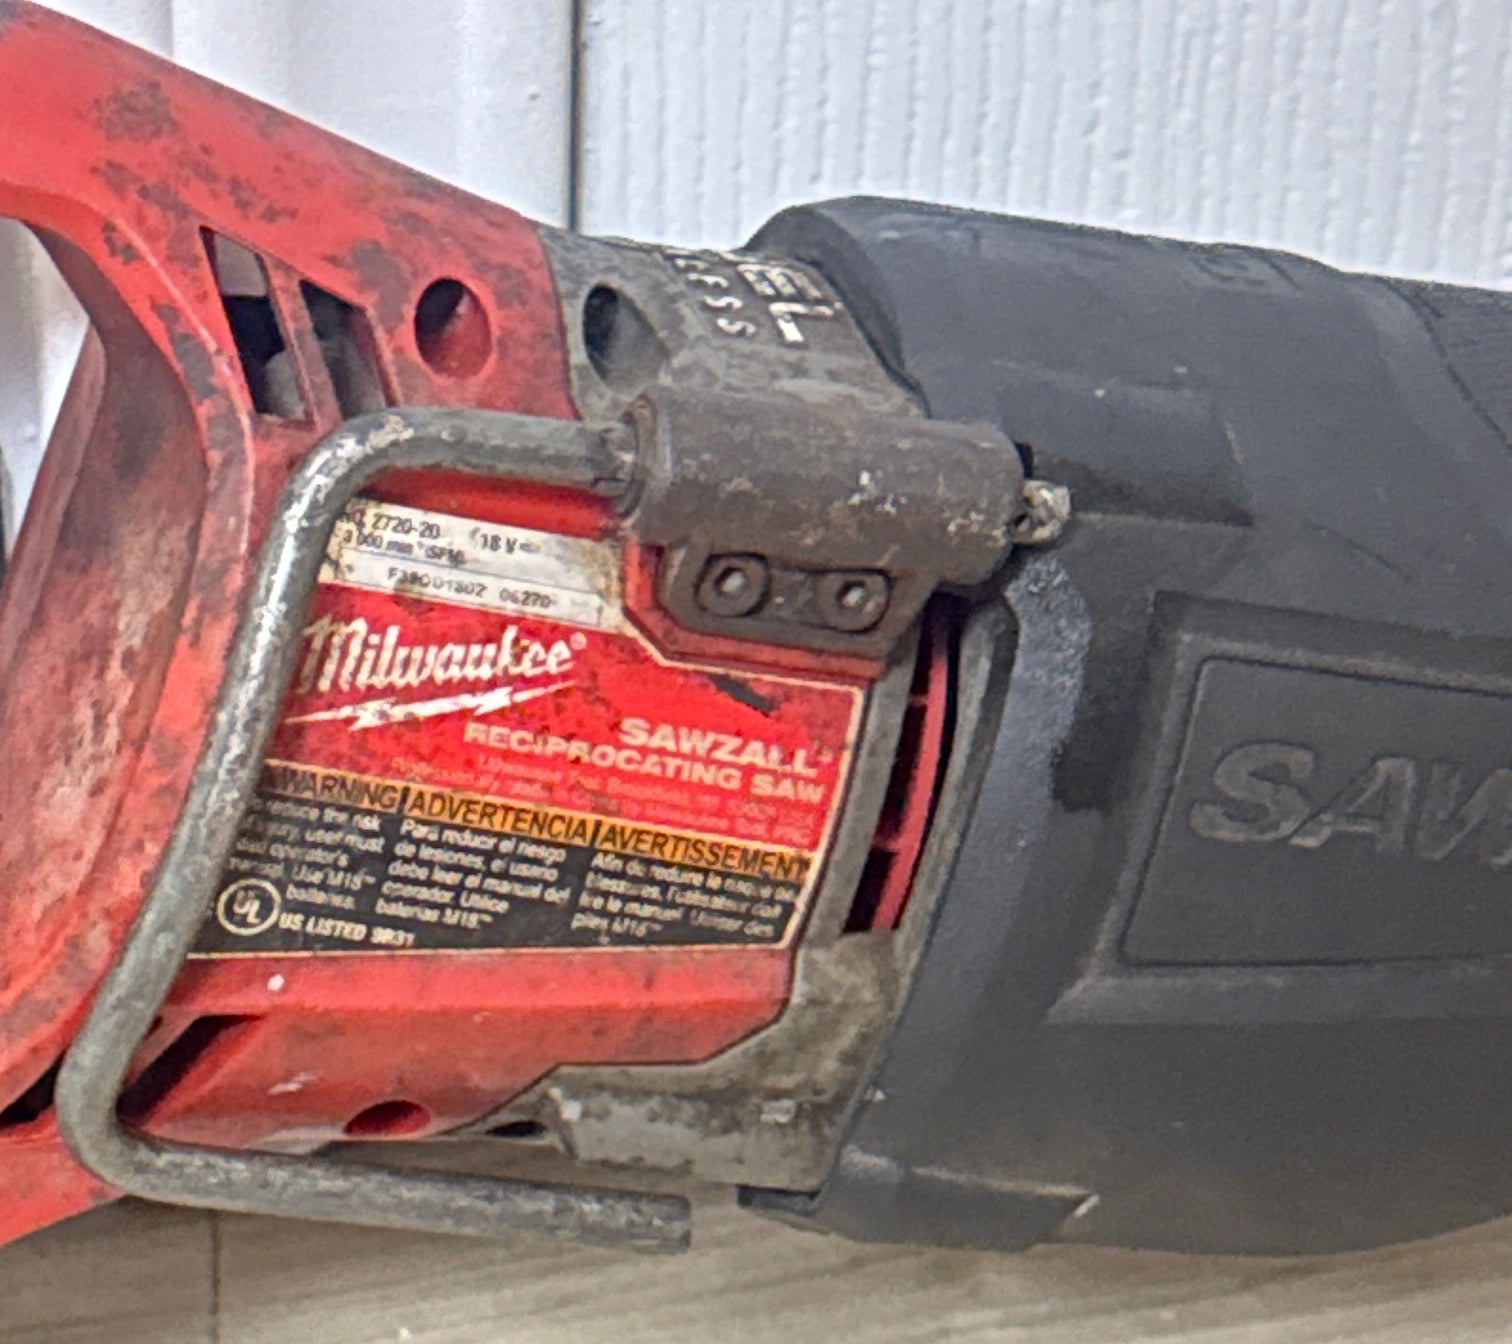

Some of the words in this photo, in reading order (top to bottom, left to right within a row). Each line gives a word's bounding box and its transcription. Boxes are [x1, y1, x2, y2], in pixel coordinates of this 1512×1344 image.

[371, 513, 440, 539] 2720-20
[479, 533, 501, 552] 18
[505, 536, 518, 554] V
[463, 720, 743, 790] RECIPROCATING
[749, 772, 826, 804] SAW
[352, 811, 381, 832] risk
[304, 828, 344, 845] user
[344, 833, 385, 854] must
[394, 840, 417, 858] de
[400, 817, 439, 842] Para
[441, 828, 498, 850] reducir
[498, 836, 517, 854] el
[517, 841, 567, 866] riesgo
[407, 793, 590, 843] ADVERTENCIA
[597, 823, 813, 884] AVERTISSEMENT
[590, 851, 624, 872] Afin
[388, 859, 430, 881] debe
[464, 872, 483, 889] el
[482, 876, 543, 899] manual
[543, 886, 572, 906] del
[305, 916, 367, 942] LISTED
